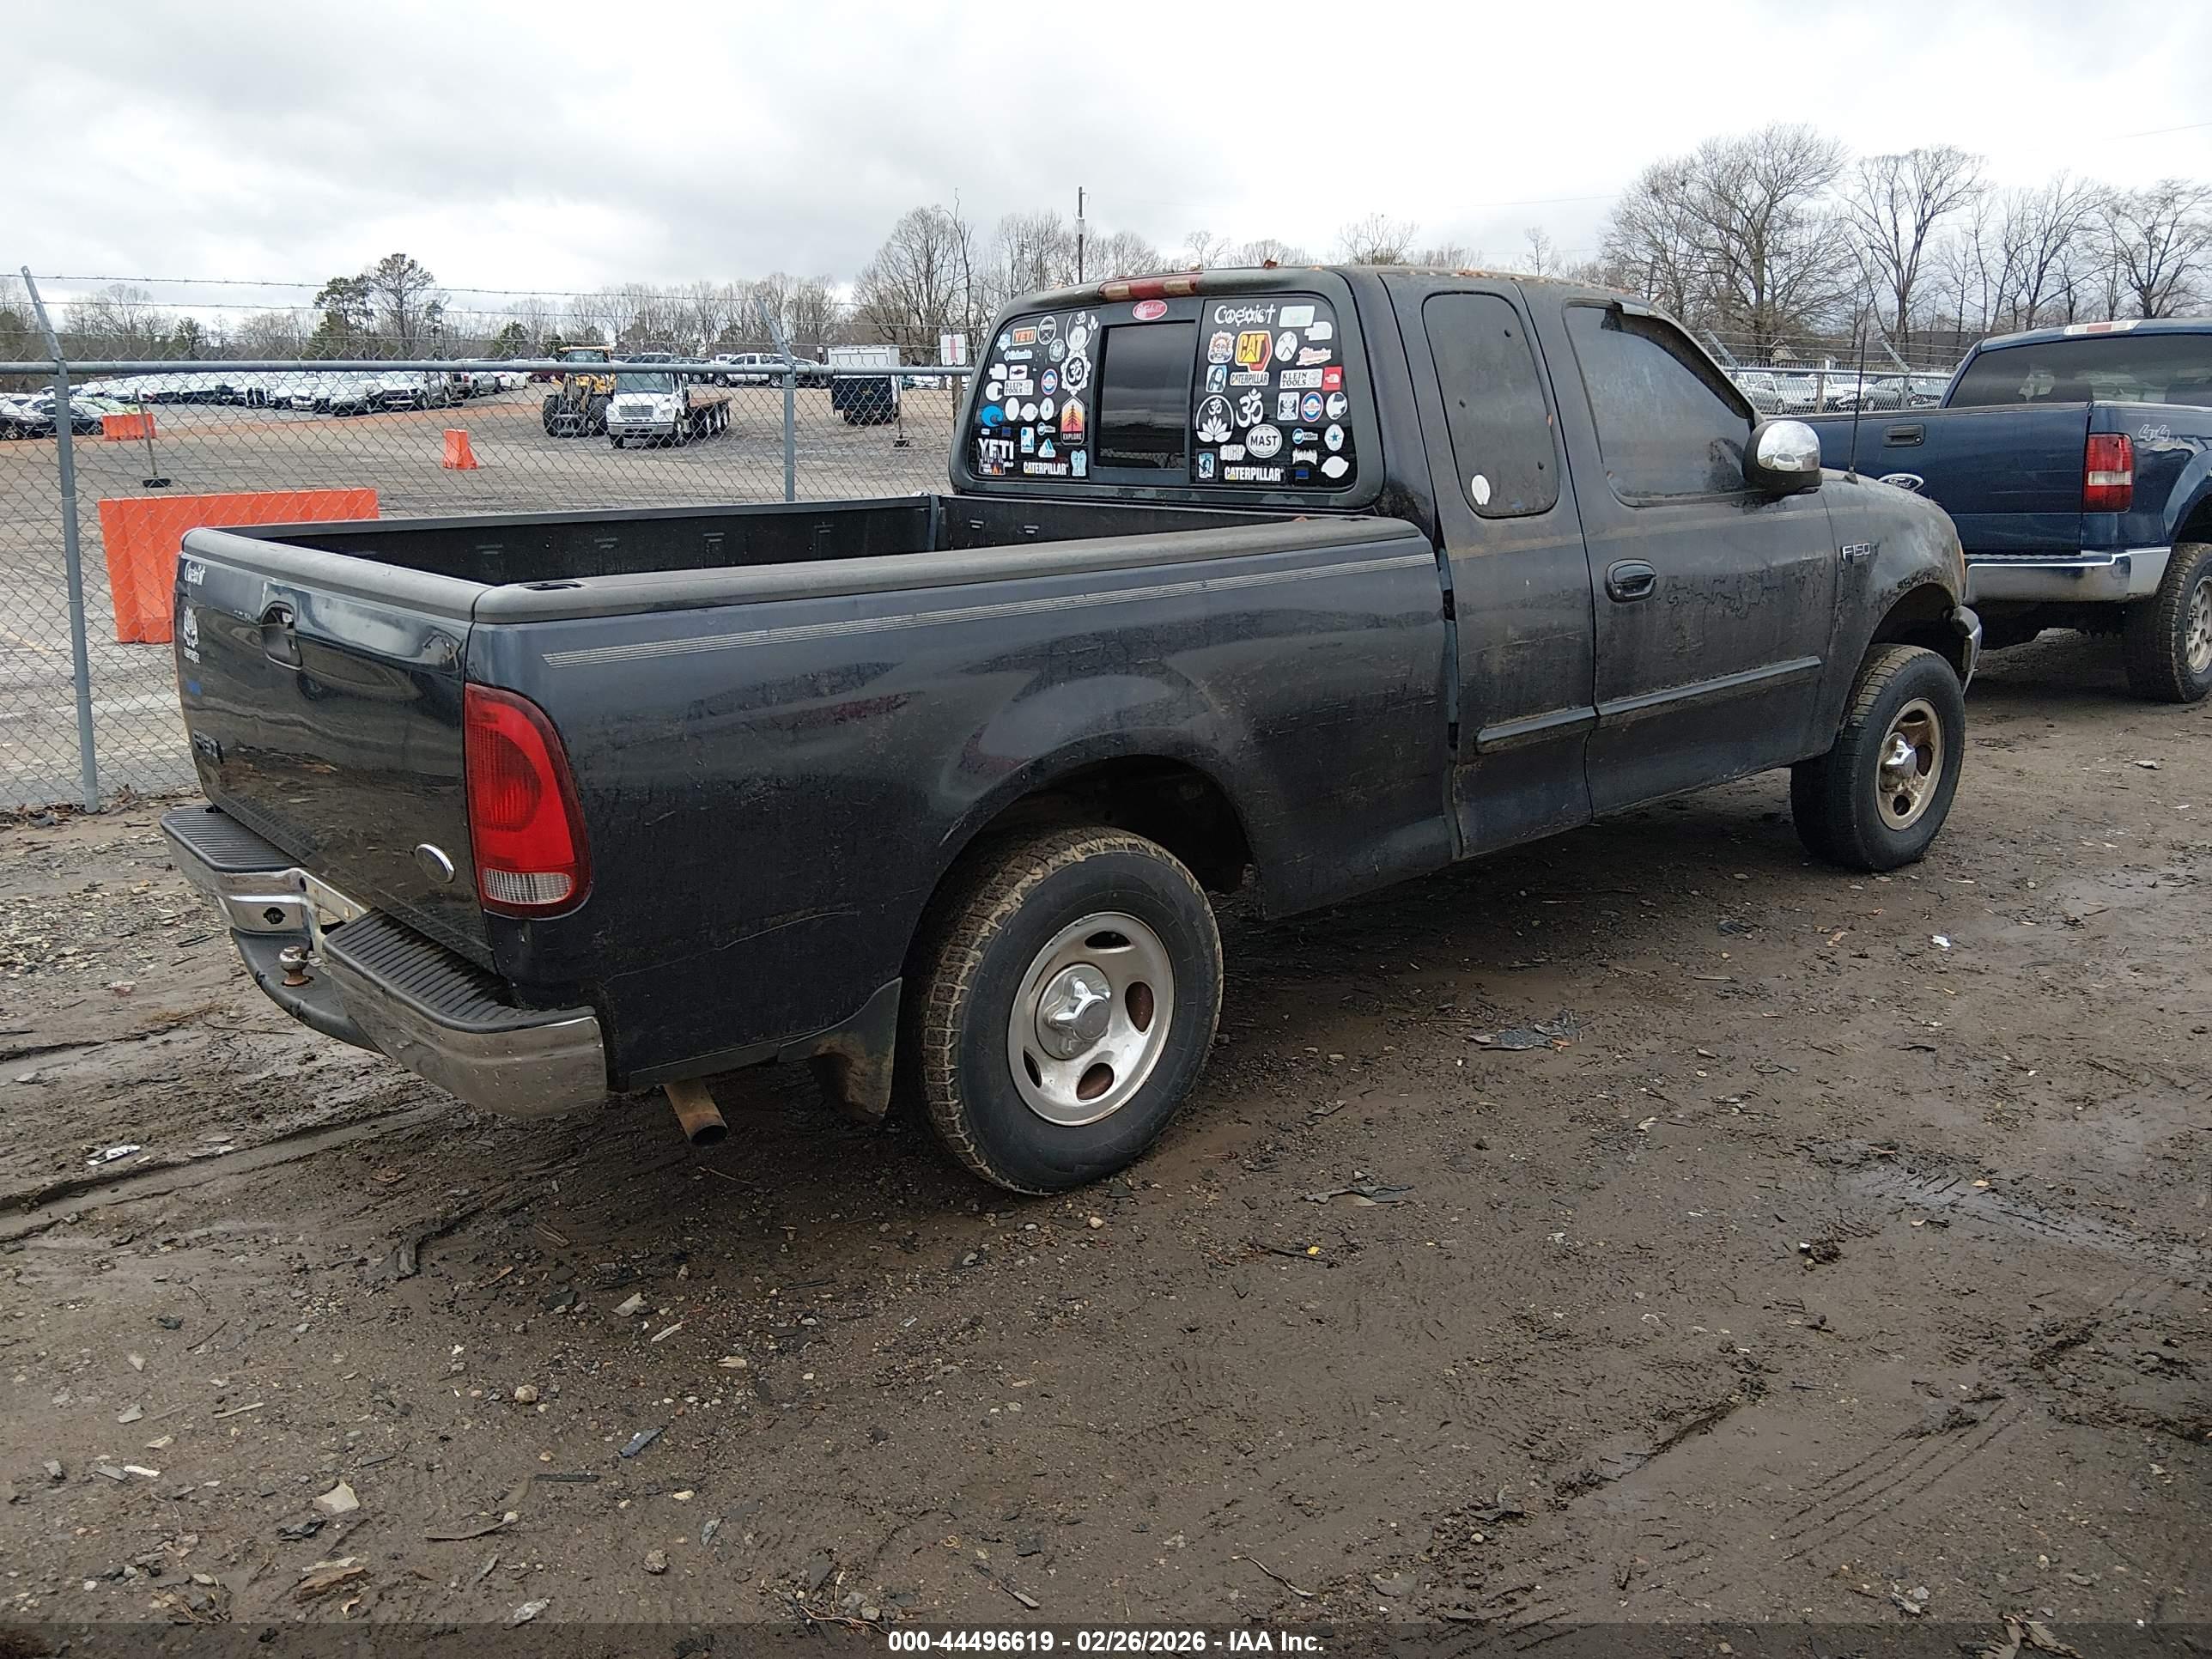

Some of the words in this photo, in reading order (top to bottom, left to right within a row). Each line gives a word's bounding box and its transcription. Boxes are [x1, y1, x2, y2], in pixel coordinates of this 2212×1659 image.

[1014, 330, 1035, 342] YETI
[1239, 333, 1264, 362] CAT
[1231, 374, 1267, 384] CATERPILLAR
[1250, 435, 1278, 446] MAST
[978, 438, 1014, 462] YETI
[1024, 462, 1067, 476] CATERPILLAR
[1224, 466, 1281, 481] CATERPILLAR
